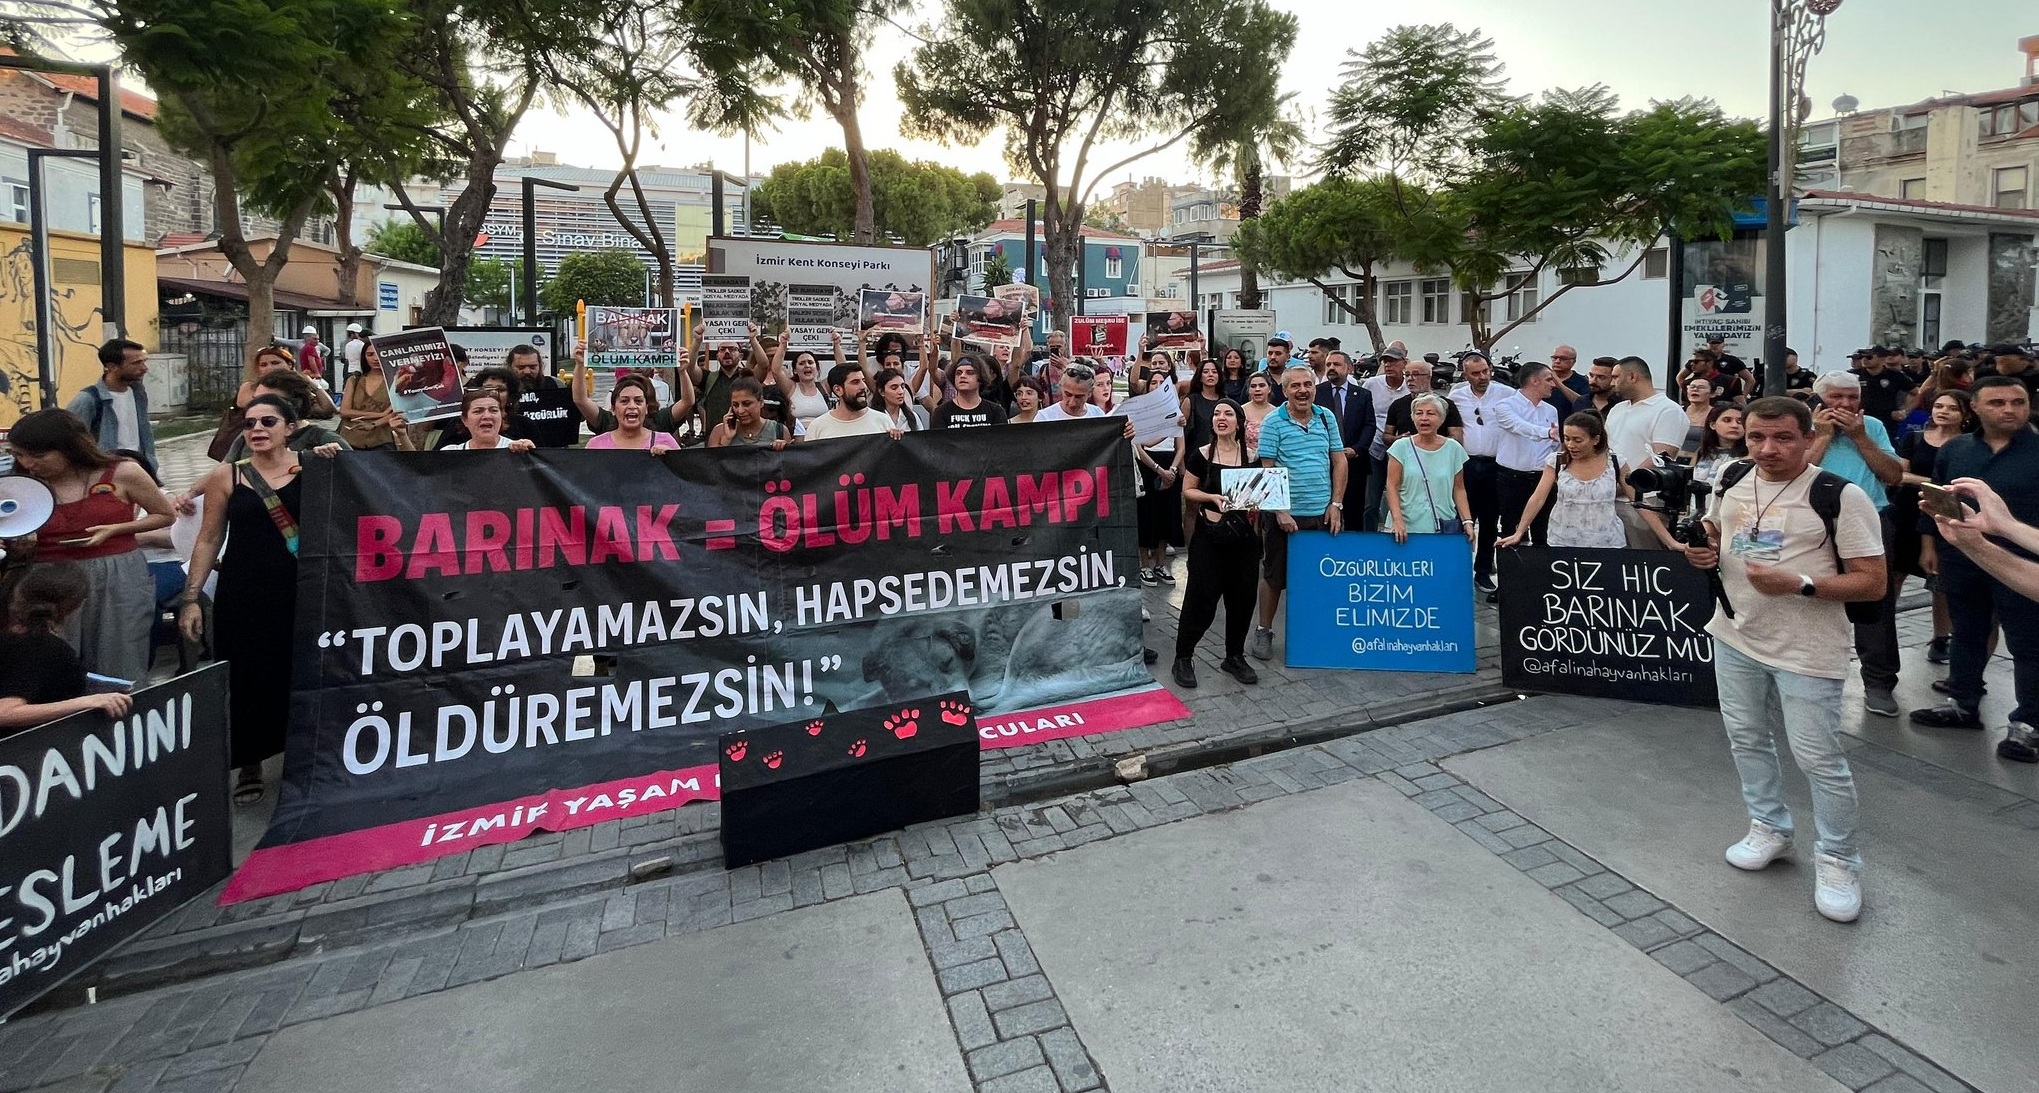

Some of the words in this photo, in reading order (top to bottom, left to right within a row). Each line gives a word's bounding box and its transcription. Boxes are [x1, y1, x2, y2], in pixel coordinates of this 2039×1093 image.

[542, 230, 596, 247] Sınav
[602, 233, 647, 248] Bina
[756, 254, 786, 266] İzmir
[788, 257, 815, 267] Kent
[817, 259, 861, 270] Konseyi
[863, 261, 890, 270] Parkı
[595, 311, 668, 325] BARINAK
[379, 341, 447, 358] CANLARIMIZI
[591, 353, 630, 364] ÖLÜM
[633, 354, 674, 364] KAMPI
[950, 414, 971, 423] FUCK
[971, 413, 987, 422] YOU
[355, 503, 681, 583] BARINAK
[758, 472, 921, 552] ÖLÜM
[936, 466, 1110, 535] KAMPI
[1319, 553, 1434, 577] ÖZGÜRLÜKLERİ
[1550, 557, 1604, 591] SİZ
[1622, 561, 1673, 596] HİÇ
[796, 545, 1127, 626] HAPSEDEMEZSİN,
[1348, 579, 1414, 604] BİZİM
[1336, 605, 1441, 629] ELİMİZDE
[1542, 593, 1696, 633] BARINAK
[1519, 624, 1661, 658] GÖRDÜNÜZ
[1666, 633, 1714, 663] MÜ
[1523, 657, 1693, 683] @afalinahayvanhakları
[979, 712, 1086, 739] CULARI
[563, 777, 701, 815] YAŞAM
